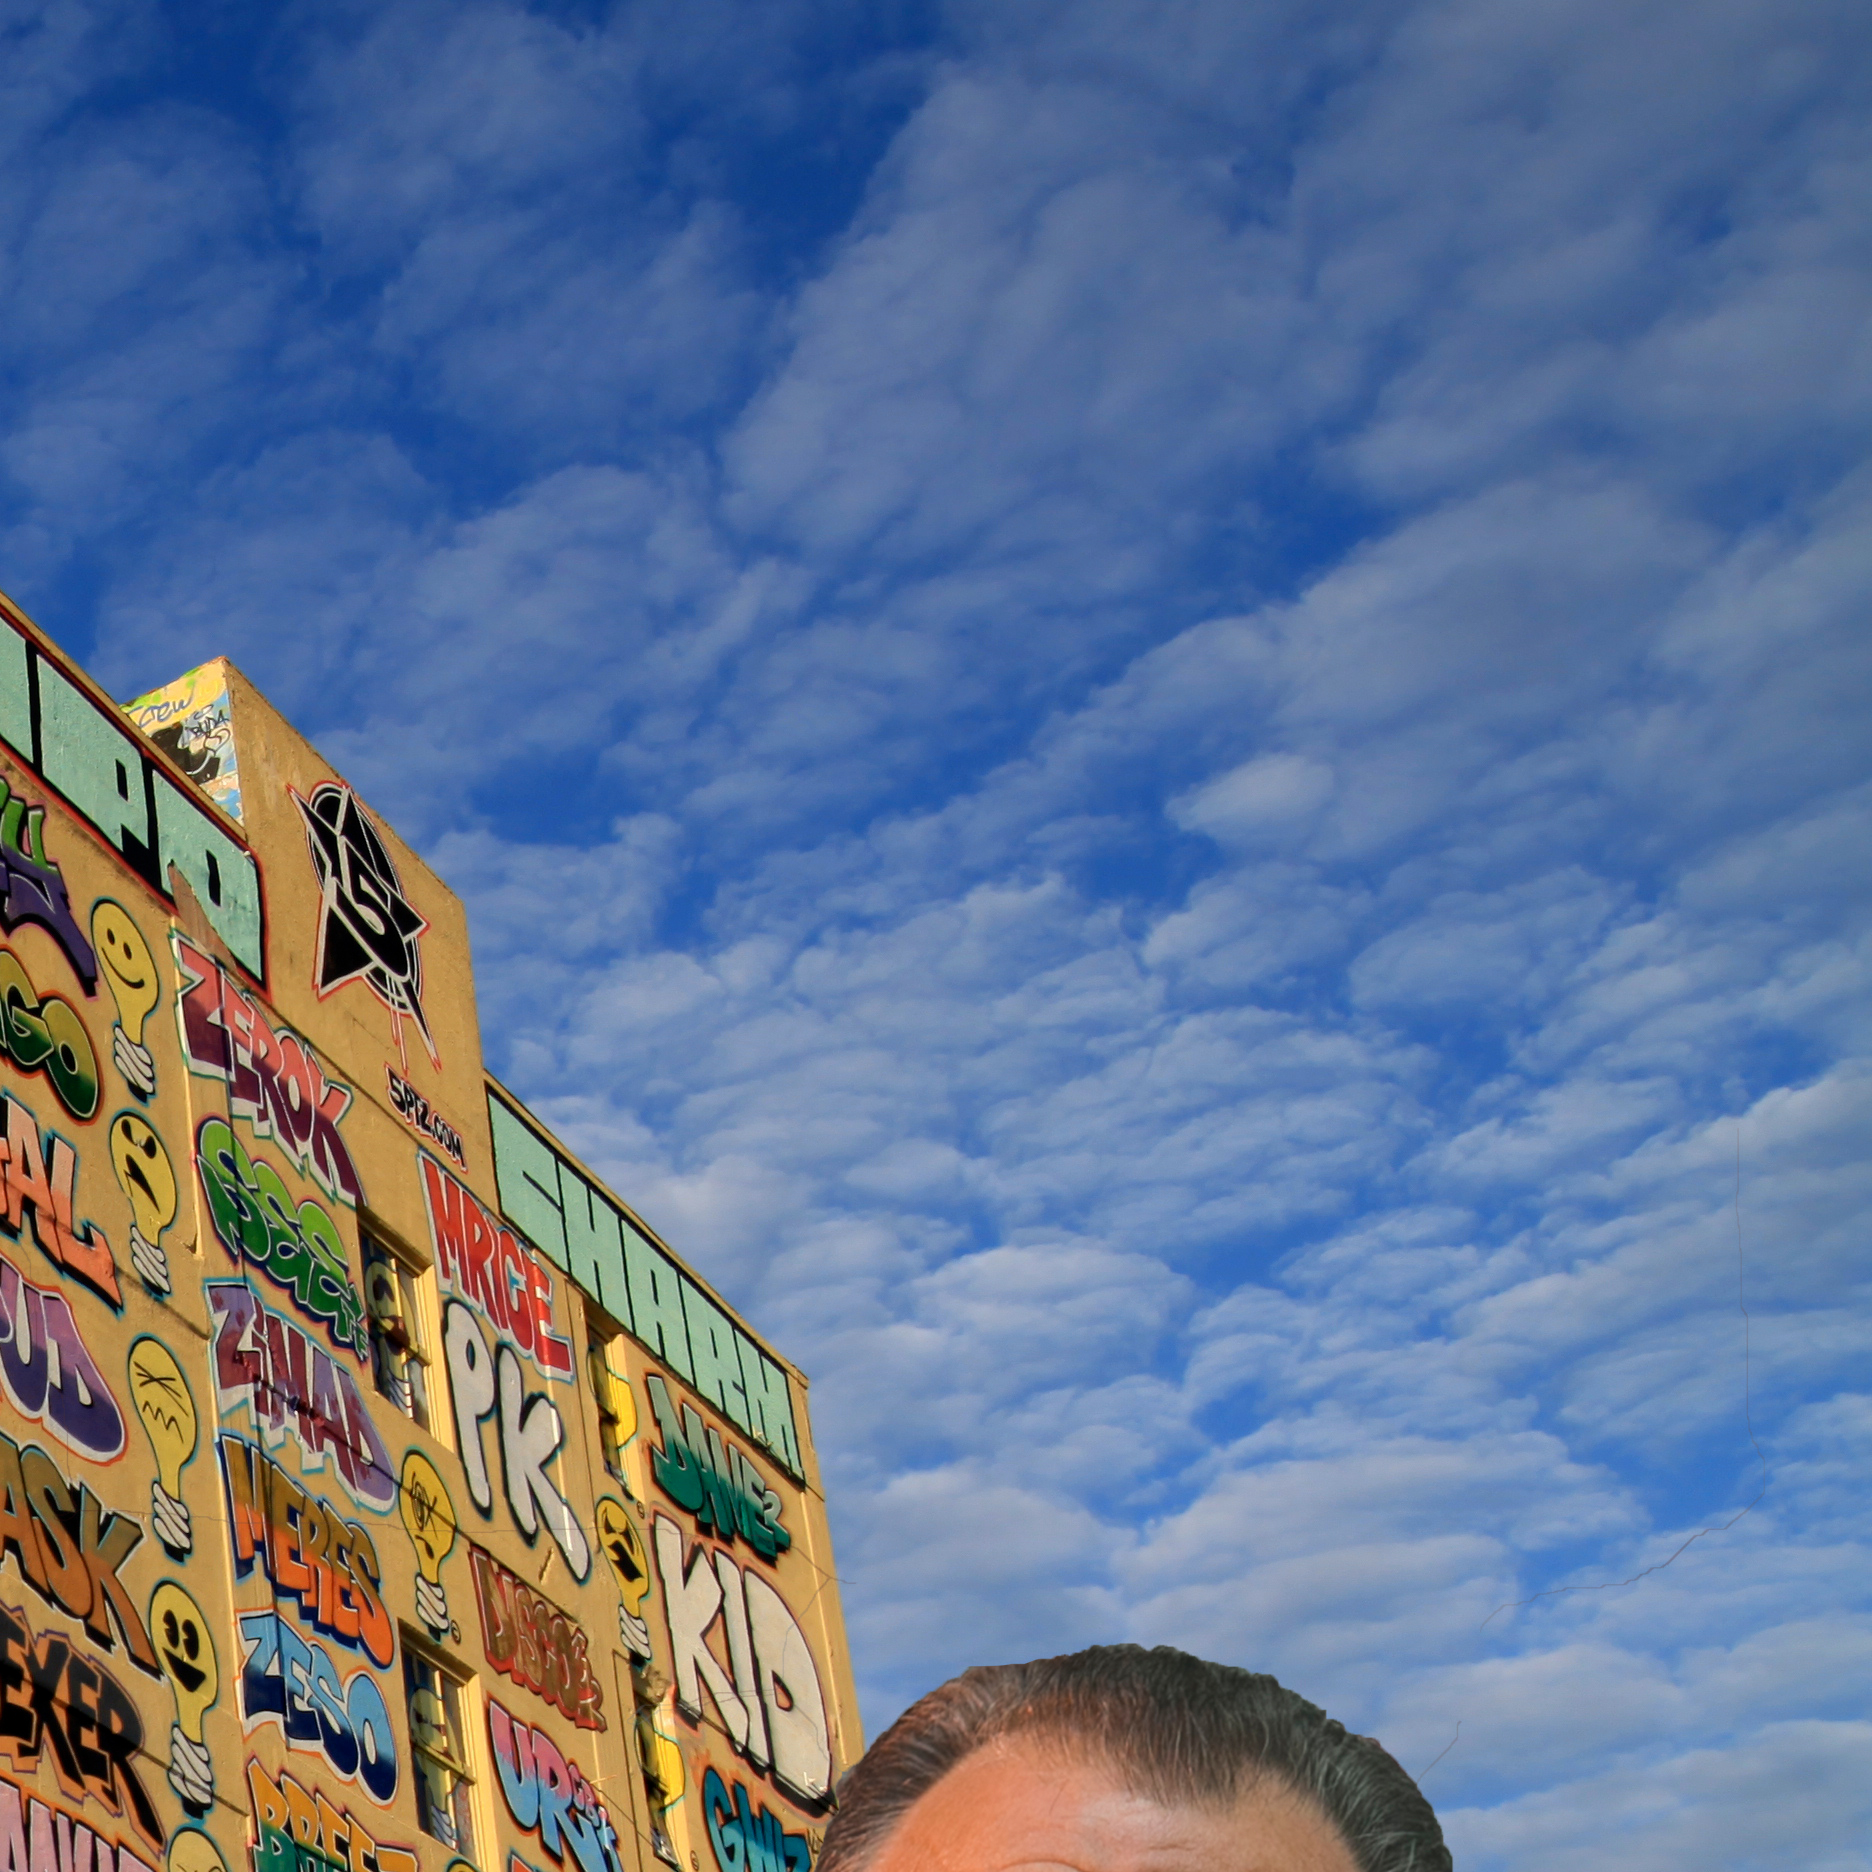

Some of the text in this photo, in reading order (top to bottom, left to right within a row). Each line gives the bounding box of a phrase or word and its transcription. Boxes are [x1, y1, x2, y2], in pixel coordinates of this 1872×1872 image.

[385, 1063, 468, 1173] 5PTZ.COM
[215, 1430, 397, 1670] MERES
[440, 1299, 591, 1583] PK
[235, 1607, 398, 1804] ZESO
[651, 1509, 838, 1812] KID
